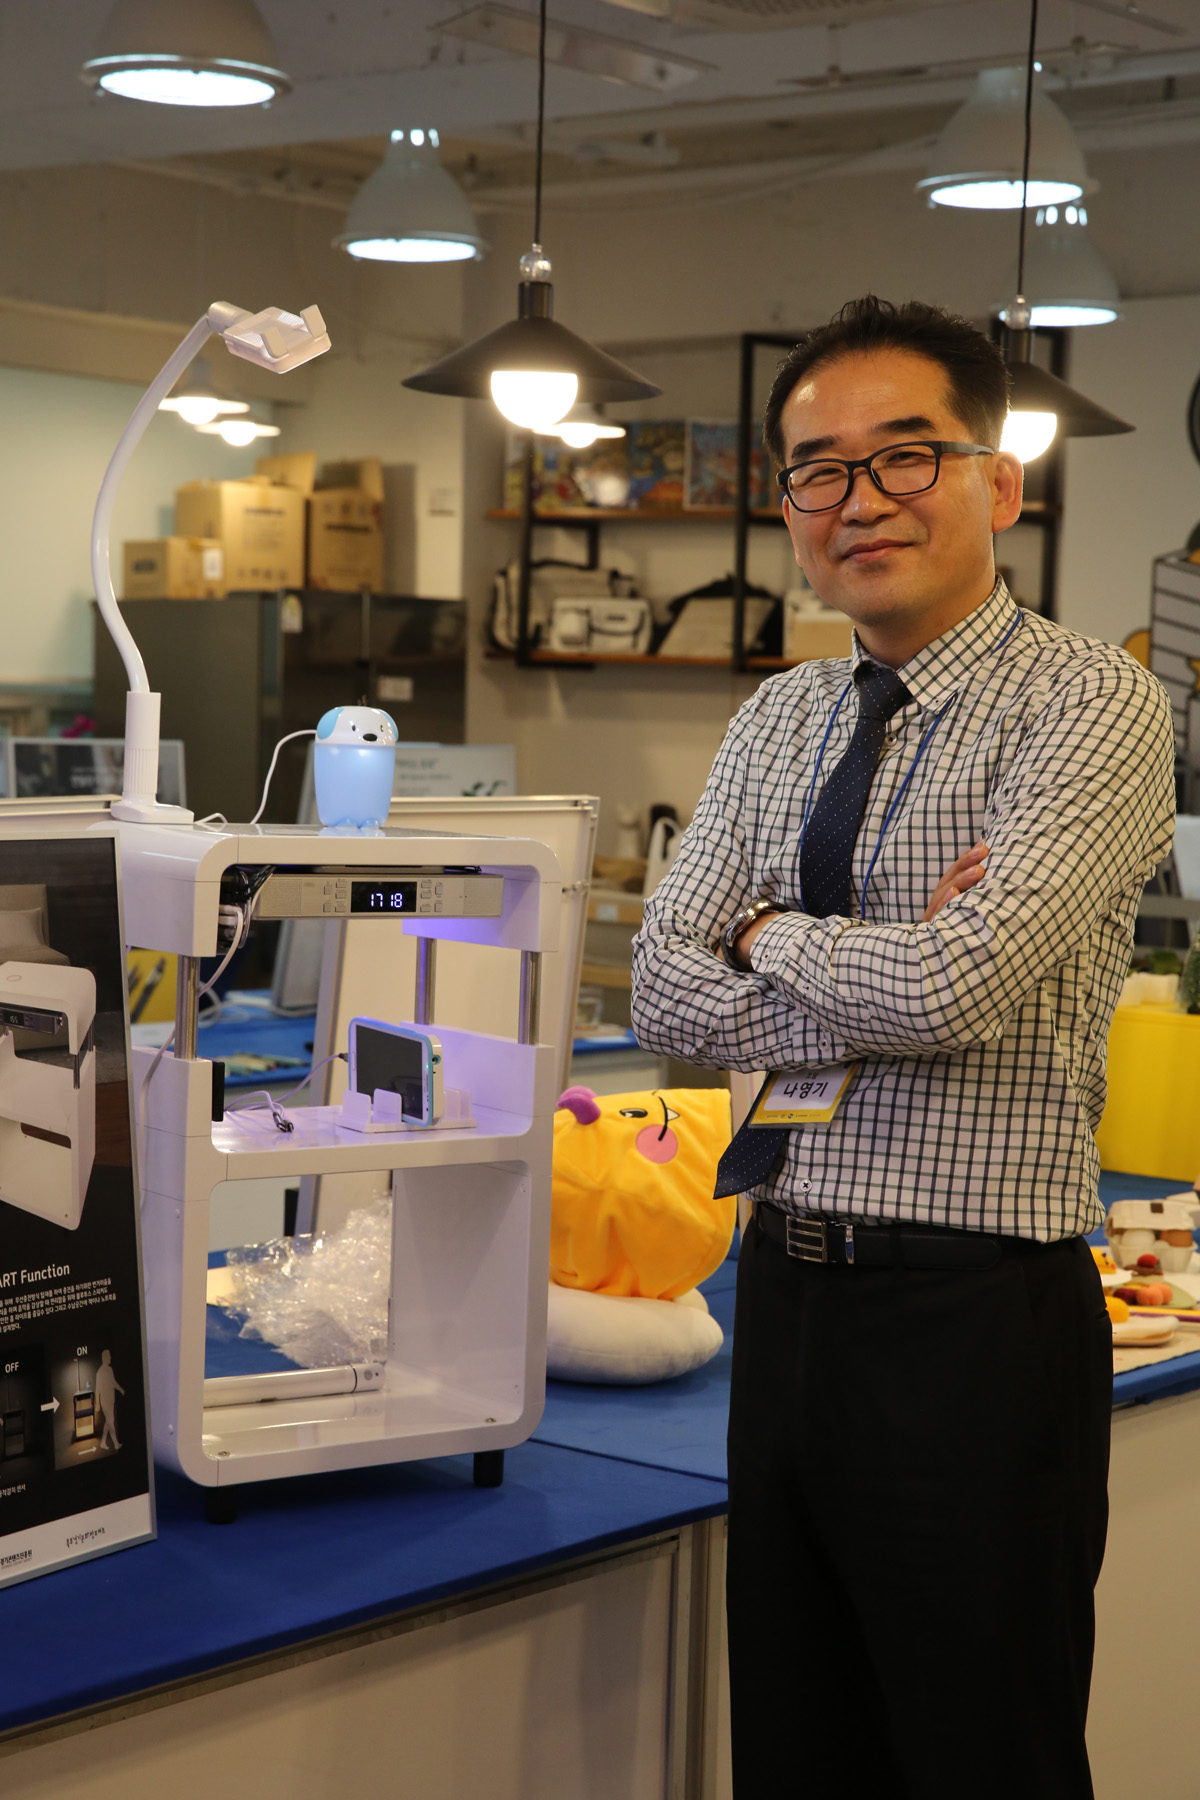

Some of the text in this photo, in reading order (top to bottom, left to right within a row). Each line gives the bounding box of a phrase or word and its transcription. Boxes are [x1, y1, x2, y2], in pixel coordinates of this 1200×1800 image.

[783, 1081, 829, 1100] 나영기
[20, 1264, 70, 1284] Function
[76, 1346, 88, 1356] ON
[5, 1361, 20, 1374] OFF
